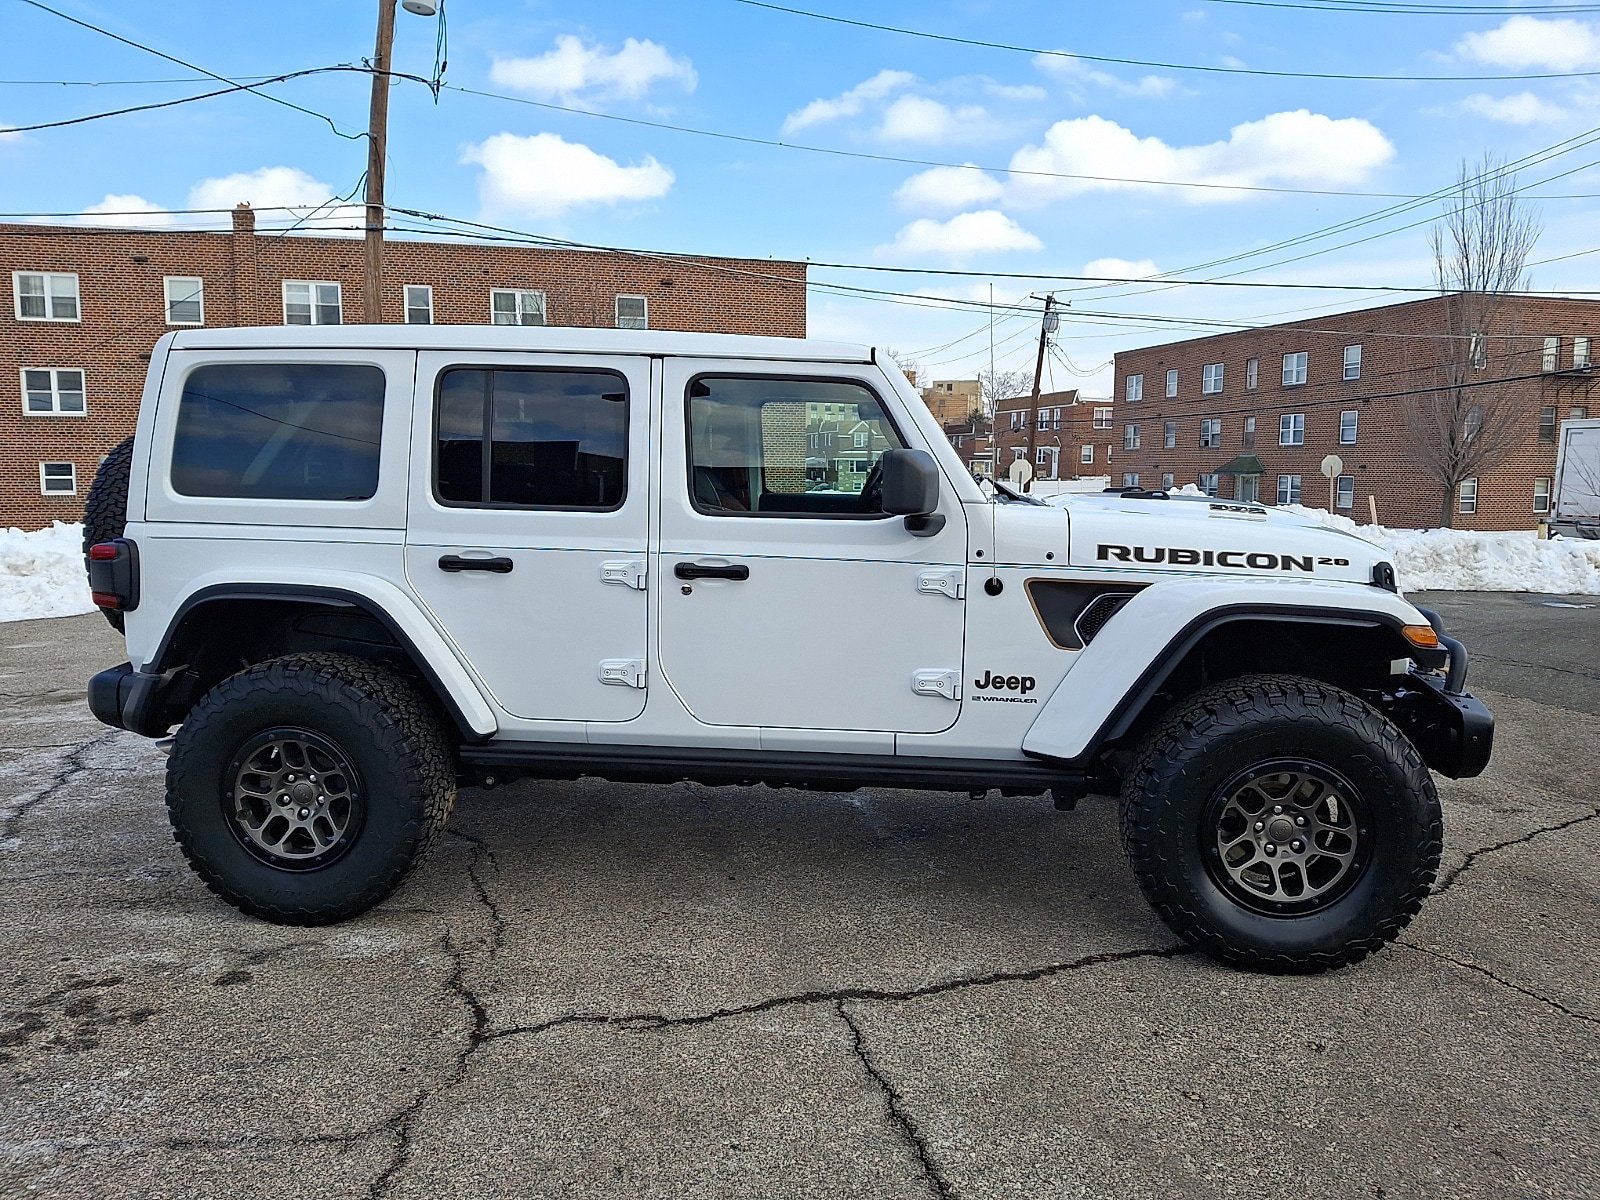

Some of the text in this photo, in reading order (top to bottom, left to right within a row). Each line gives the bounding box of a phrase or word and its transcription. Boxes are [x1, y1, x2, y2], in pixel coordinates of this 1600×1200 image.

[1096, 543, 1315, 573] RUBICON
[974, 670, 1036, 695] Jeep
[981, 695, 1038, 704] WRANGLER
